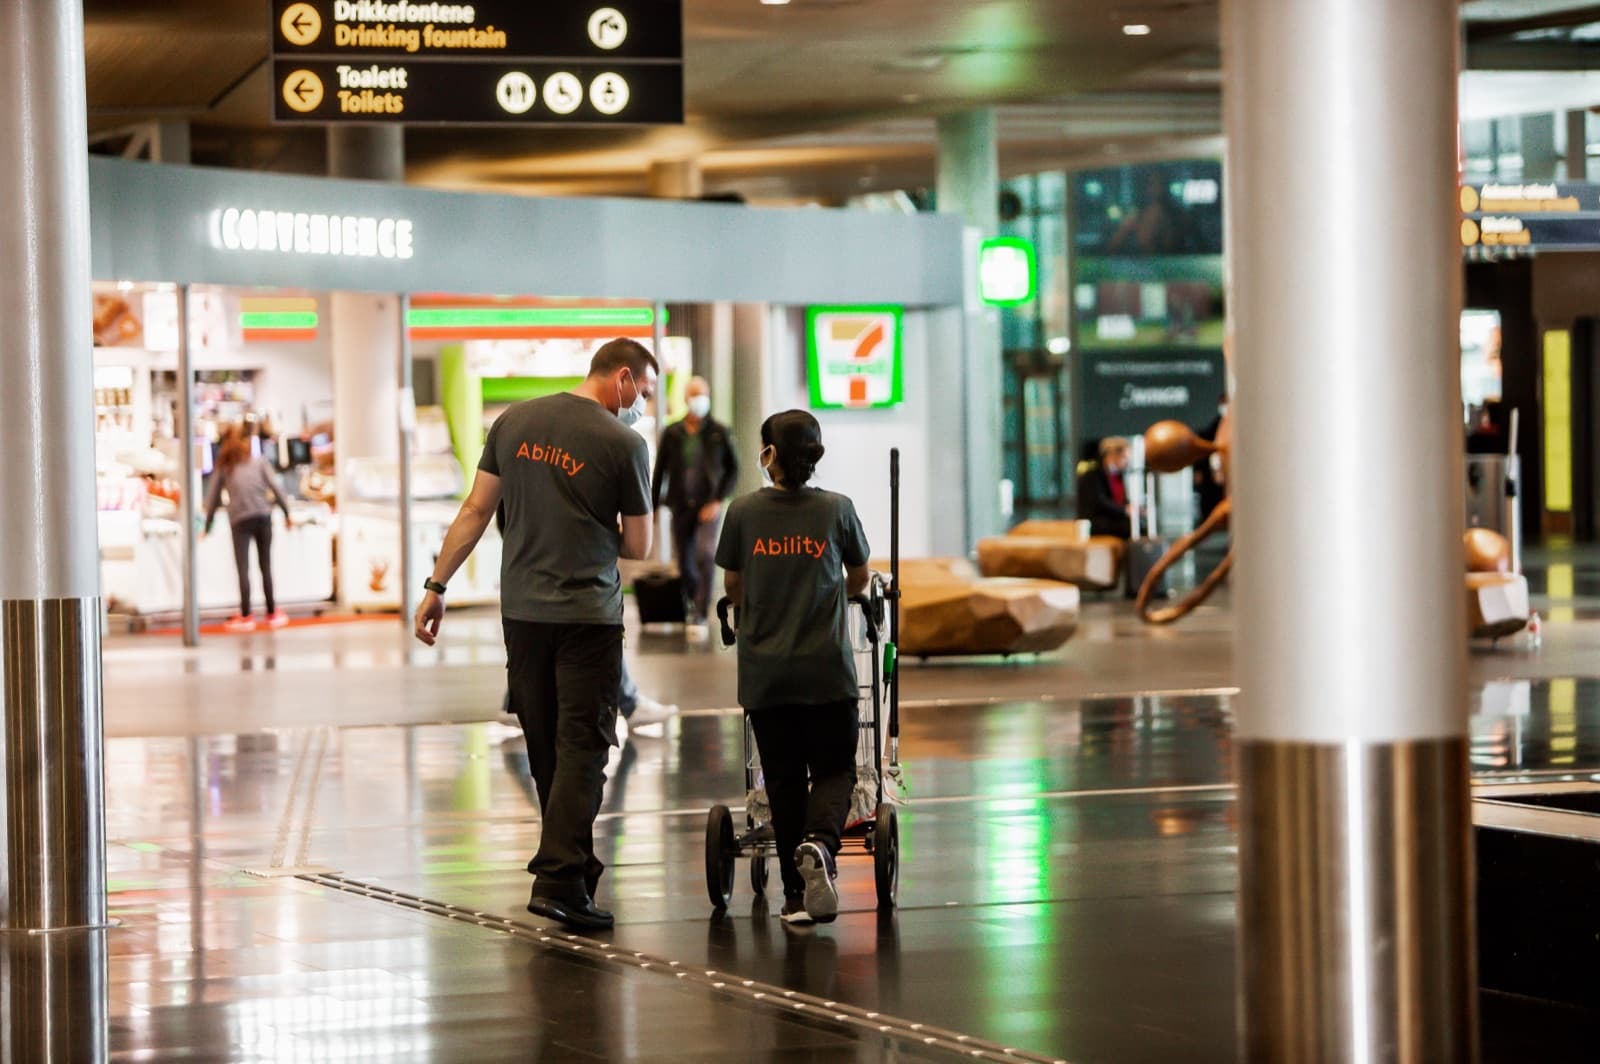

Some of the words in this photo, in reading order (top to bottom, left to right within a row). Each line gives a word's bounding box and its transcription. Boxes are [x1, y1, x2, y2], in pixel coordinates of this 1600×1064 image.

[334, 0, 475, 23] Drikkefontene
[335, 24, 420, 52] Drinking
[423, 24, 507, 48] fountain
[337, 65, 408, 89] Toalett
[337, 90, 404, 113] Toilets
[222, 207, 414, 259] CONVENIENCE
[516, 441, 585, 477] Ability
[753, 535, 828, 560] Ability
